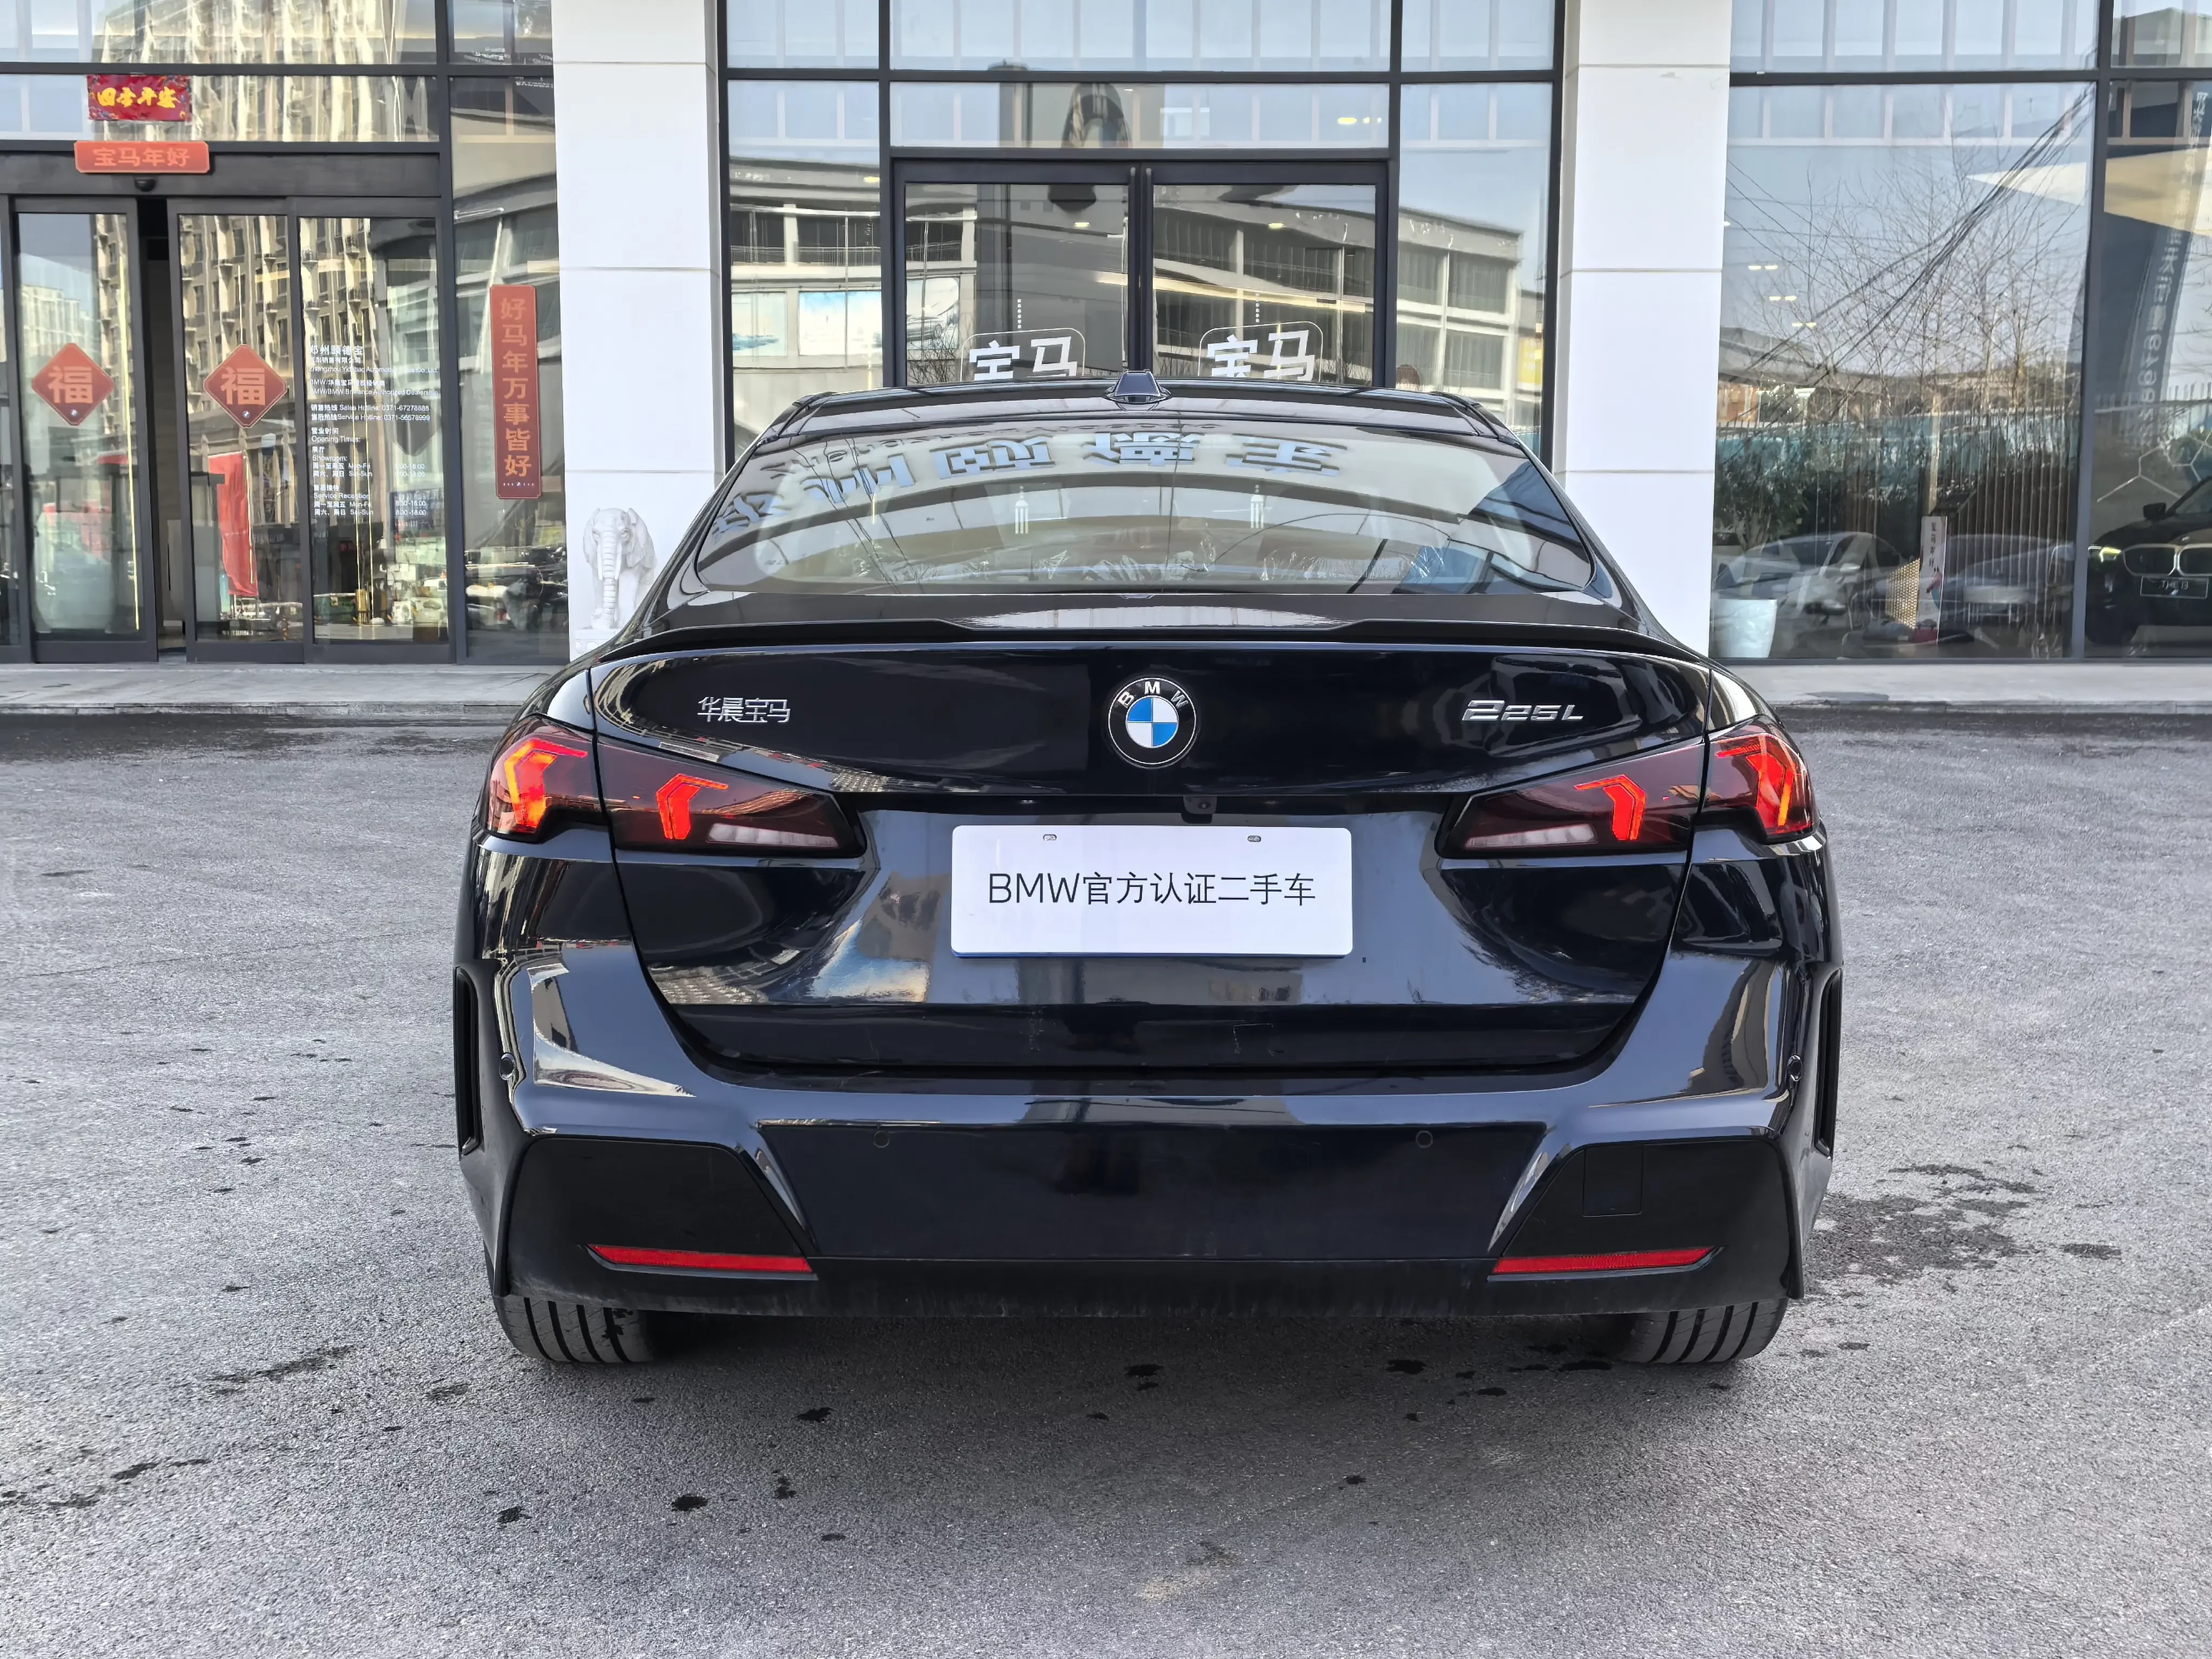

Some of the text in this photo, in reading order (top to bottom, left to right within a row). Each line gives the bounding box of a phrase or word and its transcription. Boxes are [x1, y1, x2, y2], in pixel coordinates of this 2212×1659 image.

[92, 146, 191, 167] 宝马年好
[968, 336, 1078, 381] 宝马
[1206, 329, 1316, 381] 宝马
[48, 366, 94, 404] 福
[220, 367, 266, 406] 福
[499, 297, 532, 477] 好马年万事皆好
[697, 696, 791, 724] 华晨宝马
[1117, 680, 1189, 709] BMW
[1461, 699, 1584, 721] 225L
[988, 871, 1316, 907] BMW官方认证二手车
